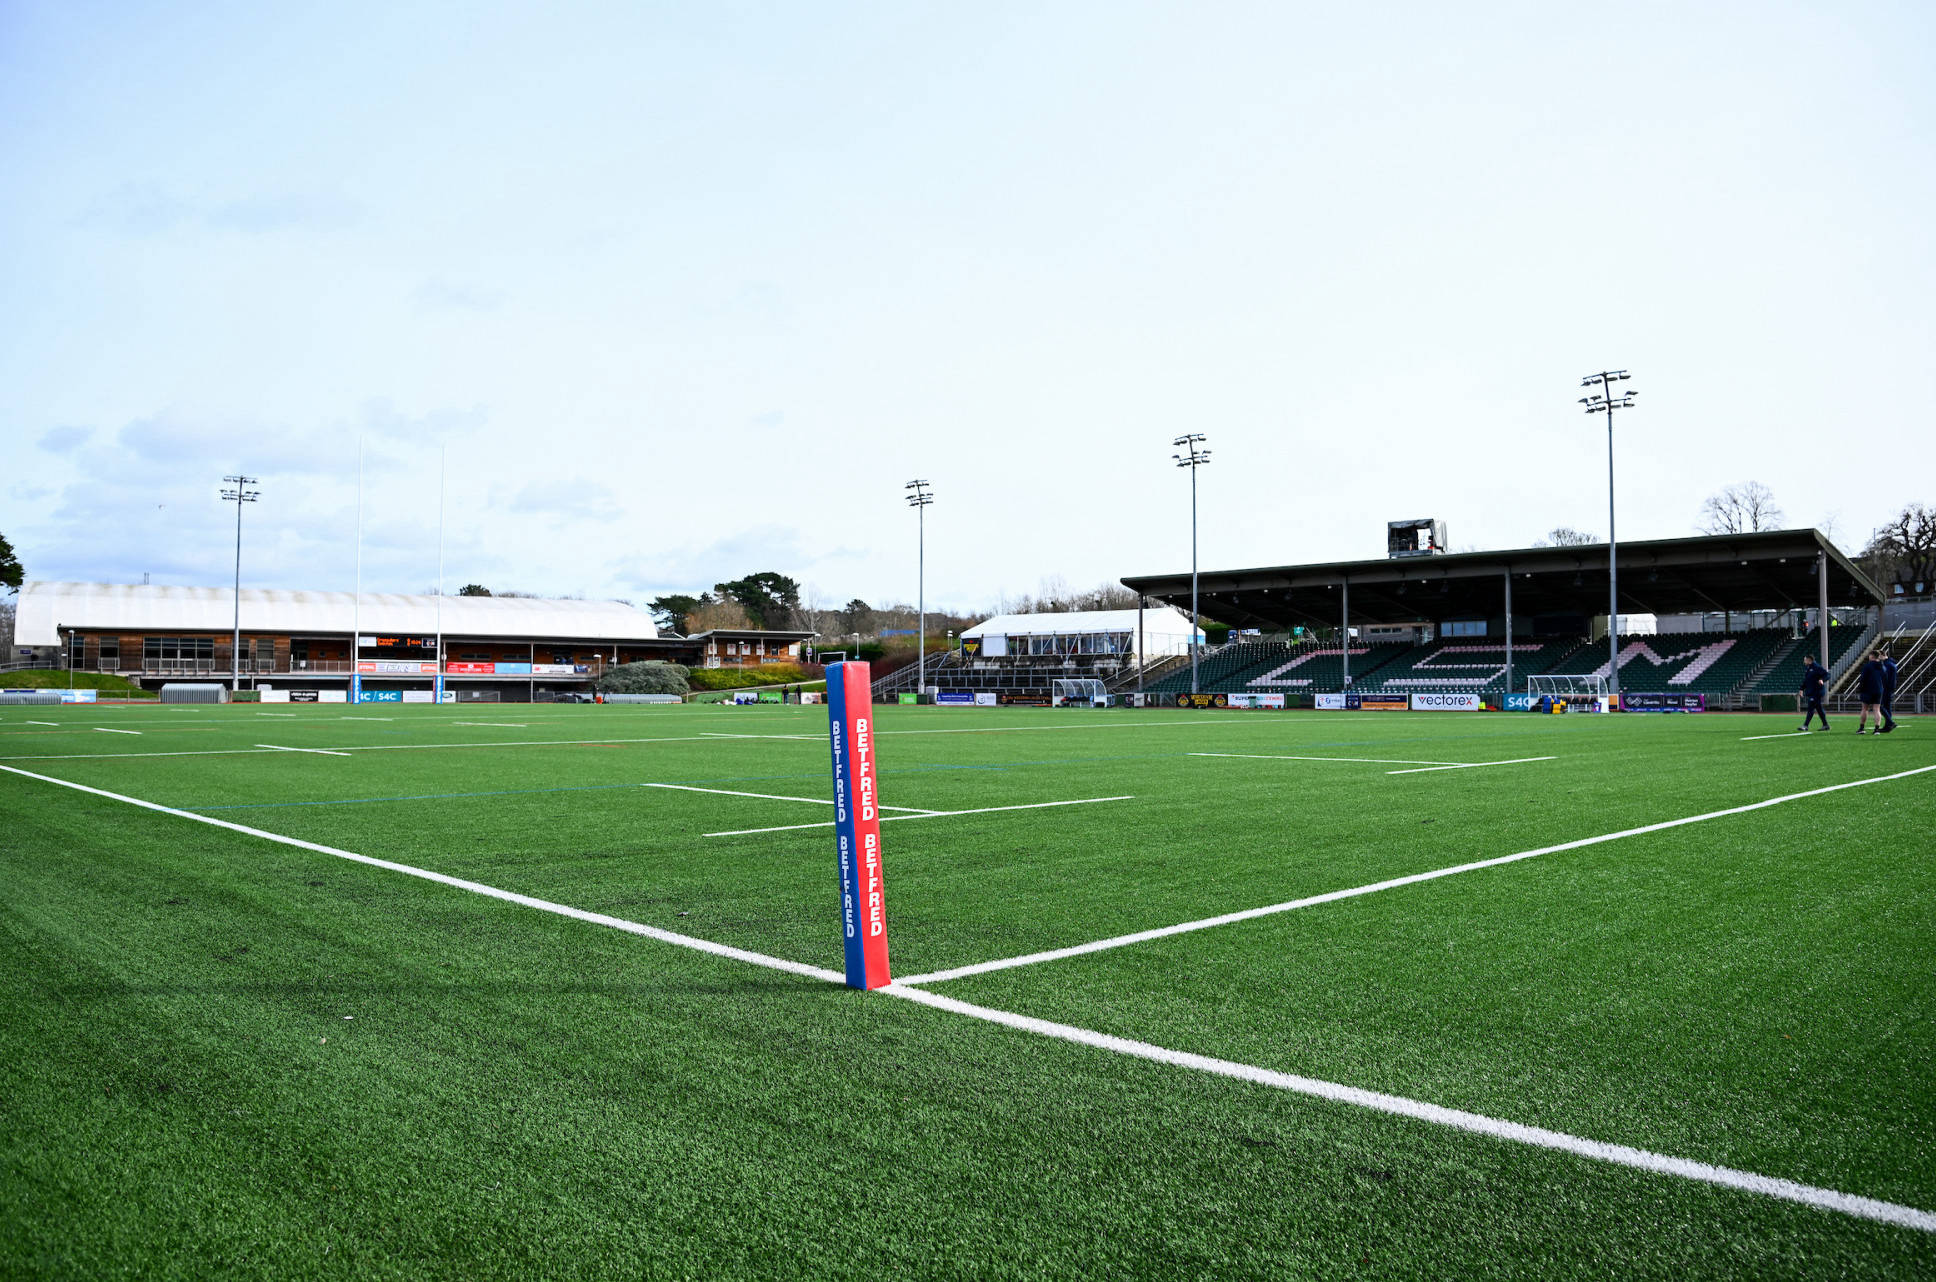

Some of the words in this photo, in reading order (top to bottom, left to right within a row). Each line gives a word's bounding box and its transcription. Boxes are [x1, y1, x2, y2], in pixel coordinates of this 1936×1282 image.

[378, 692, 397, 700] S4C
[1418, 694, 1473, 706] vectorex
[832, 720, 846, 823] BETFRED
[856, 718, 875, 822] BETFRED
[840, 835, 854, 938] BETFRED
[864, 833, 883, 937] BETFRED
